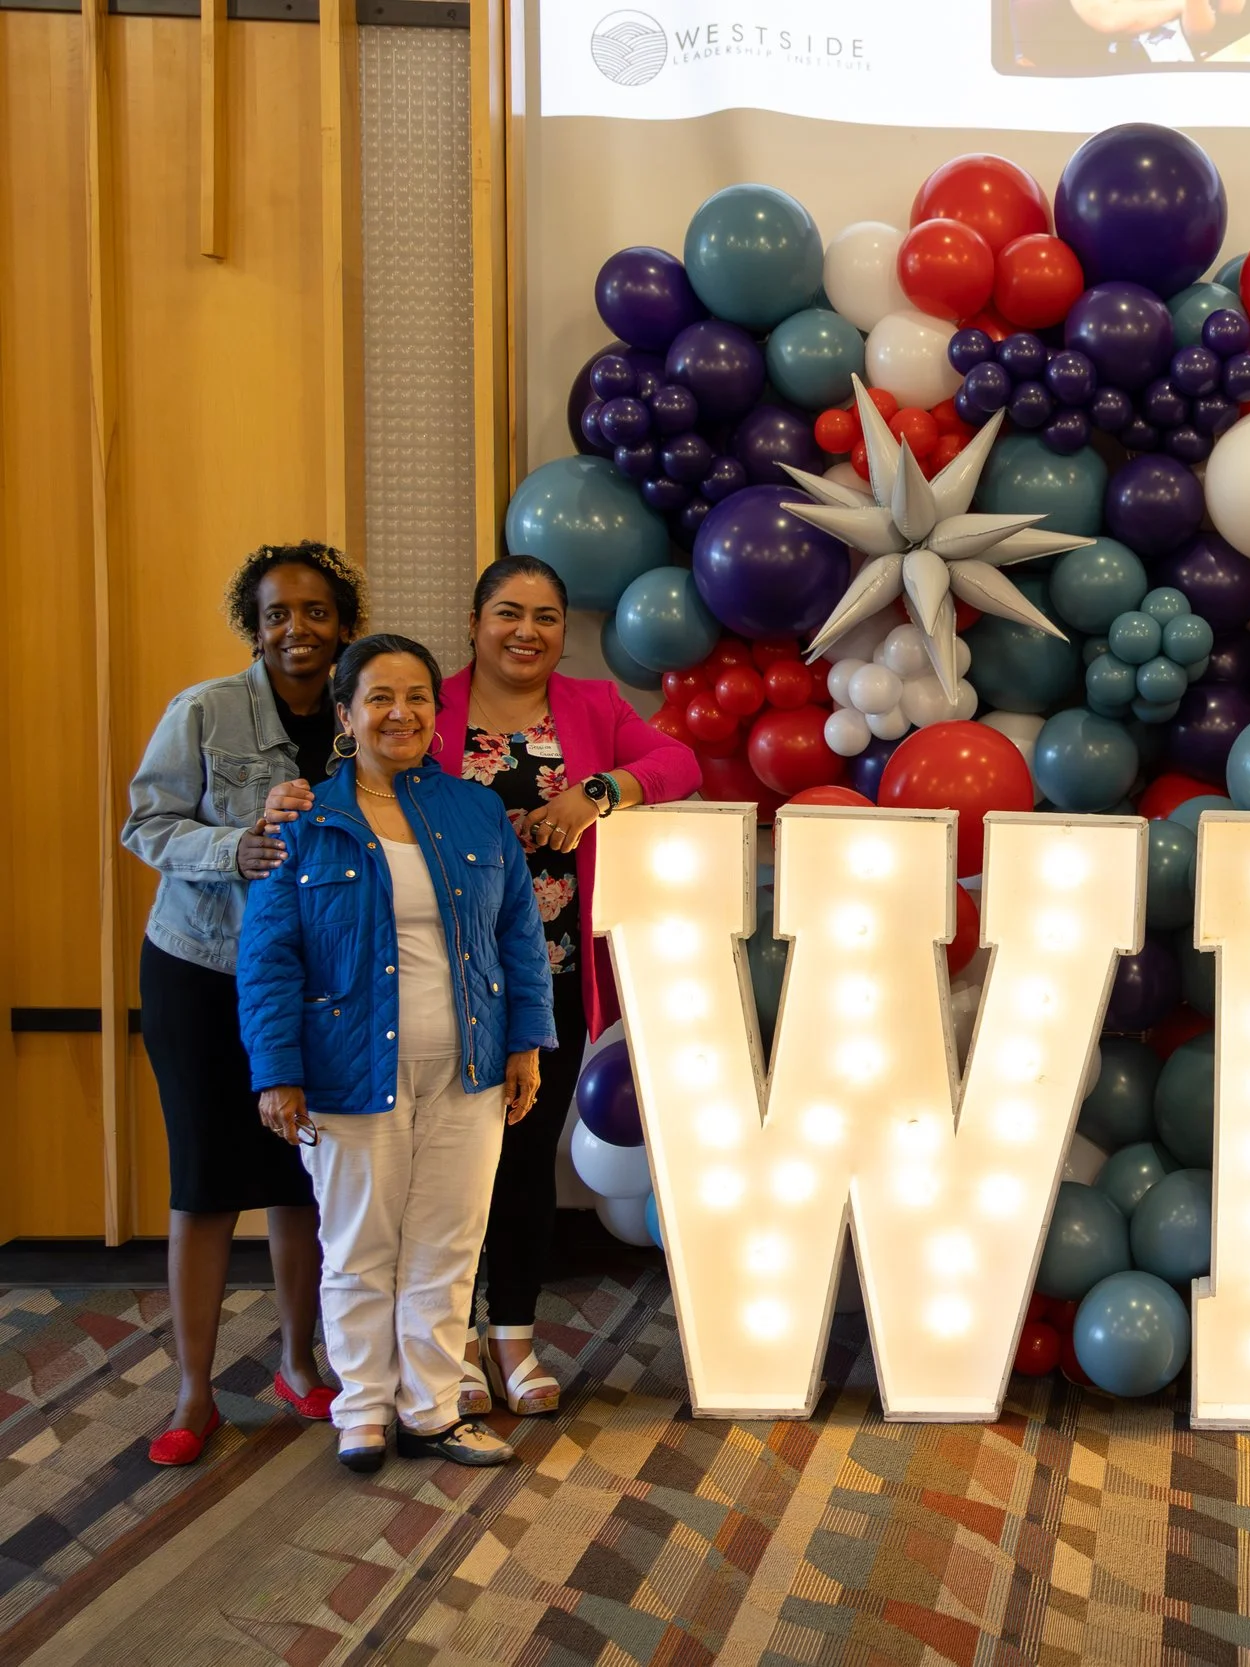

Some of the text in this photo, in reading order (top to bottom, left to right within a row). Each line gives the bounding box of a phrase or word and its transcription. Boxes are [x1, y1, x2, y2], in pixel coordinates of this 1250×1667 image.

[675, 23, 863, 58] WESTSIDE
[673, 46, 872, 71] LEADERSHIP INSTITUTE
